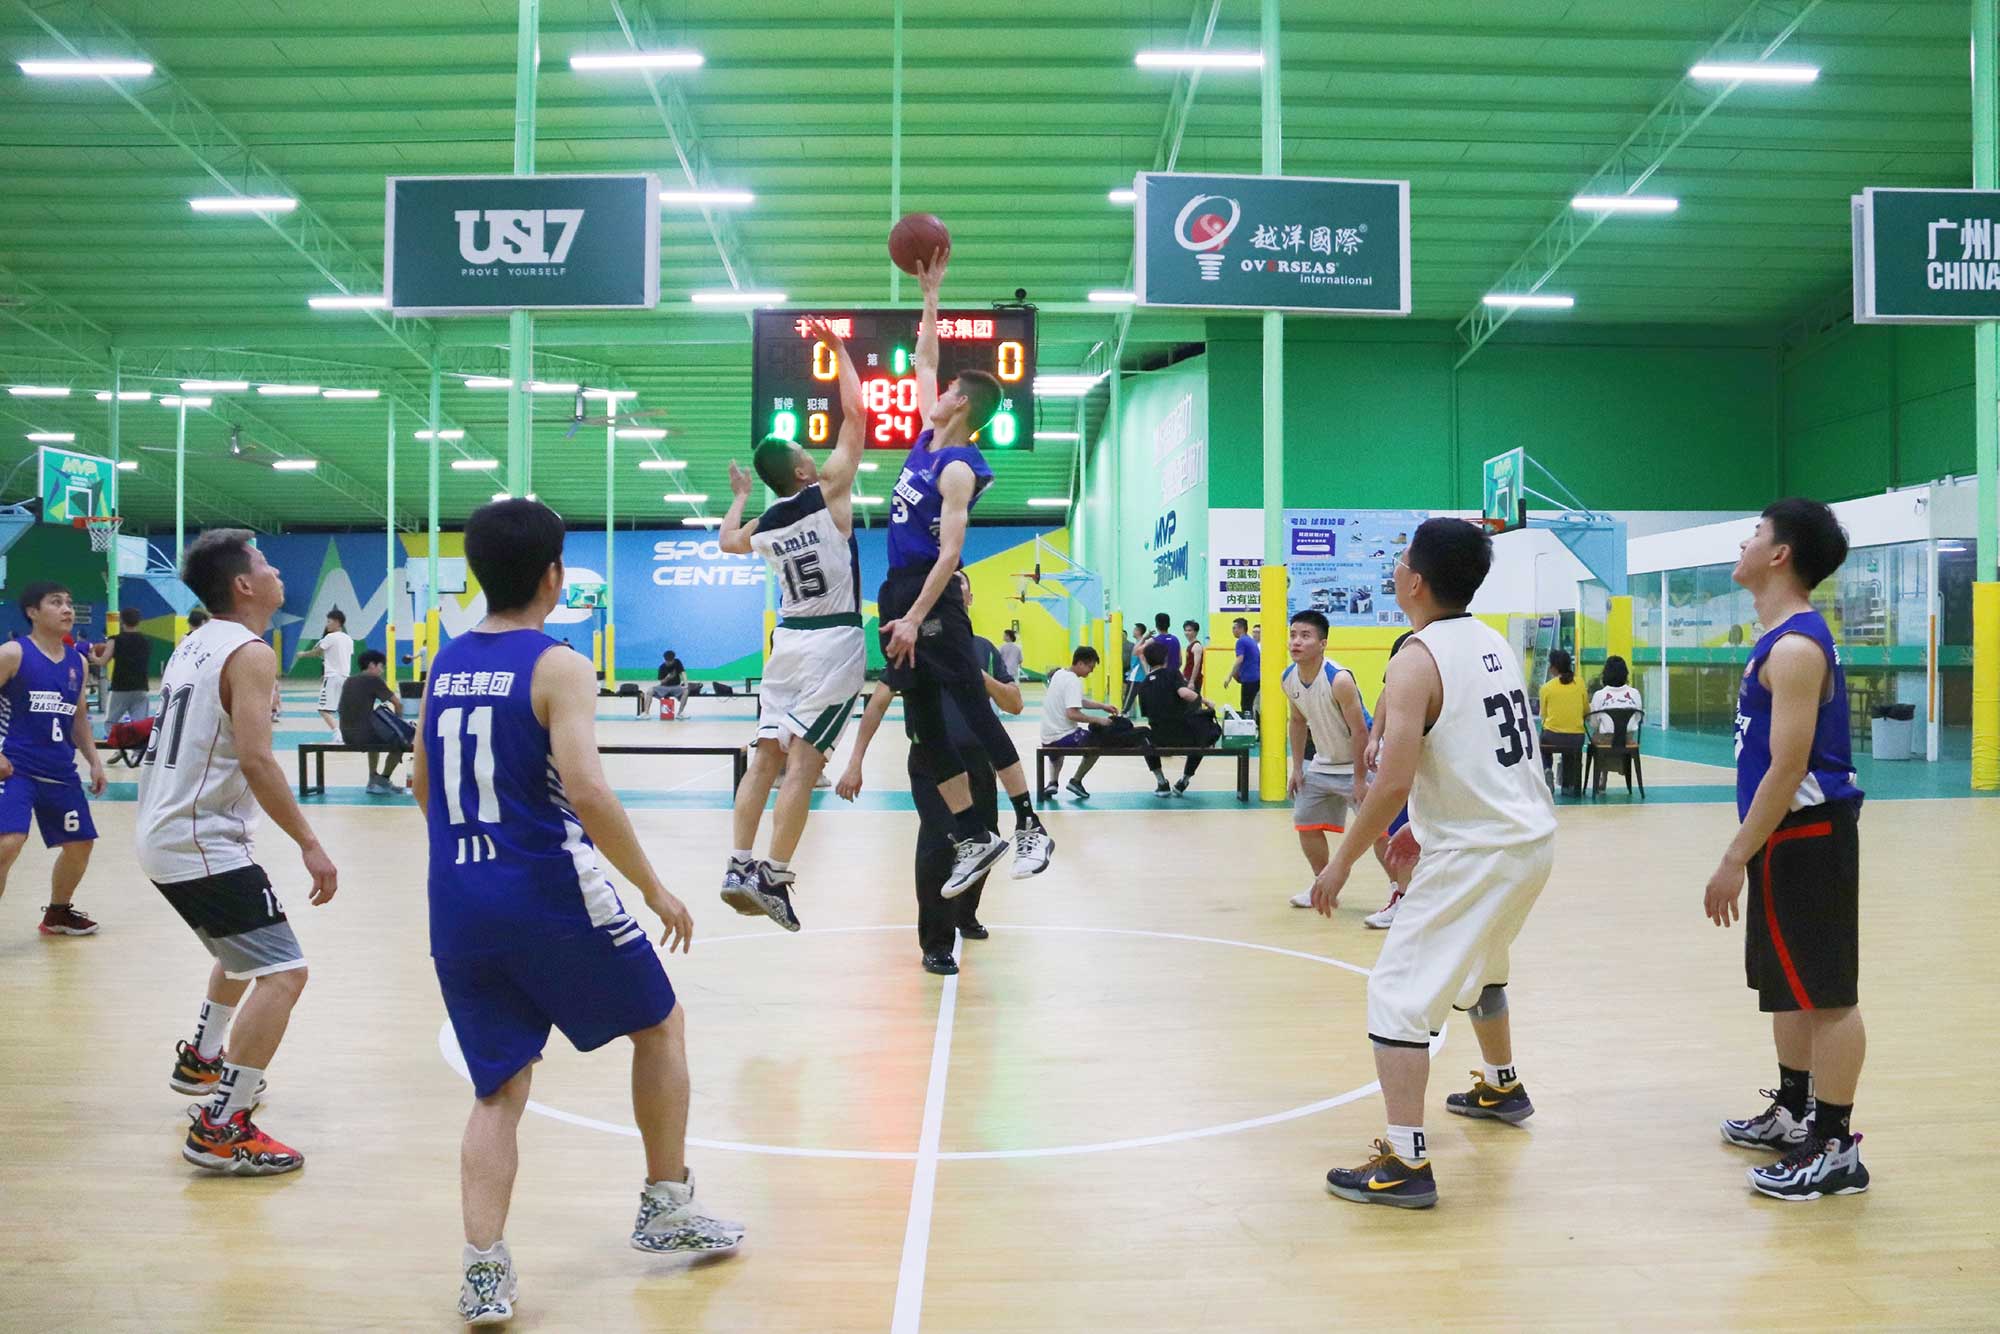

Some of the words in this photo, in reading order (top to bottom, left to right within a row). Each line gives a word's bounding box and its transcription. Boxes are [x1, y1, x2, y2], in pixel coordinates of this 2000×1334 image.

[1249, 224, 1364, 256] 越洋國際
[1927, 218, 2000, 260] 广州
[461, 268, 499, 277] PROVE
[507, 267, 567, 276] YOURSELF
[1241, 259, 1336, 274] OVERSEAS
[917, 318, 993, 339] 志集团
[812, 341, 837, 381] 0
[998, 341, 1023, 381] 0
[808, 413, 829, 443] 0
[875, 412, 913, 442] 24
[783, 550, 828, 604] 15
[1227, 568, 1260, 579] 贵重物
[1227, 594, 1260, 605] 内有监
[433, 672, 516, 697] 卓志集团
[52, 718, 63, 742] 6
[437, 706, 502, 825] 11
[64, 810, 79, 832] 6
